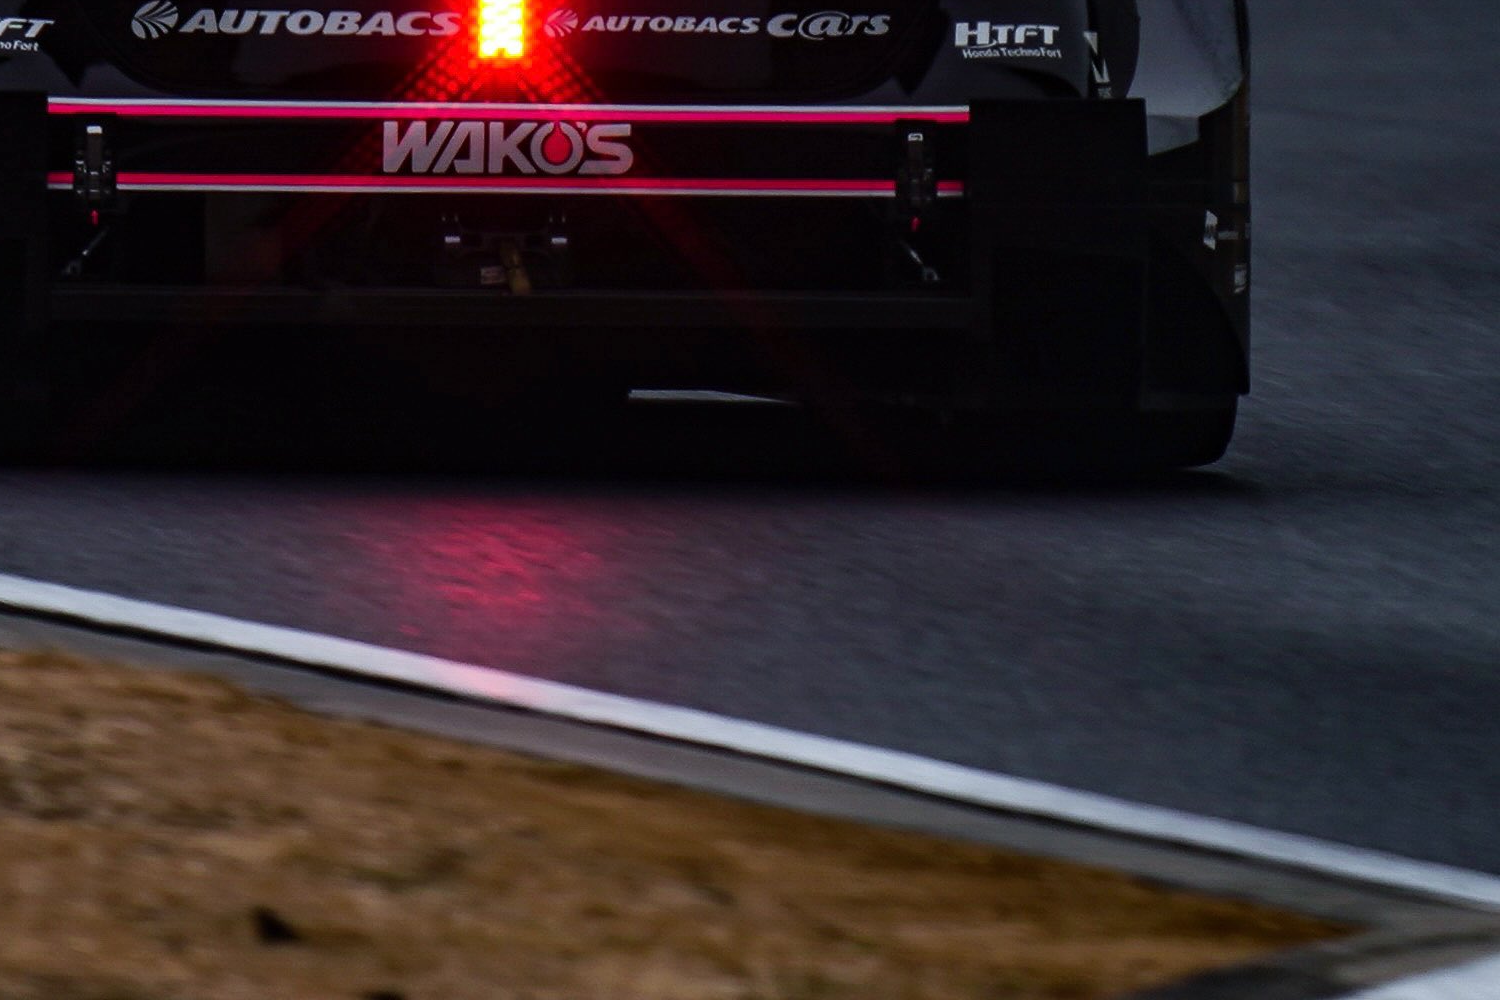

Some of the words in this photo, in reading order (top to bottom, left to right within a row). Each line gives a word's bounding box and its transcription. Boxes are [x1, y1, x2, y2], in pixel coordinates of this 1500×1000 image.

[178, 8, 462, 37] AUTOBACS
[581, 14, 761, 34] AUTOBACS
[954, 21, 1061, 49] HTFT
[382, 119, 635, 176] WAKO'S
